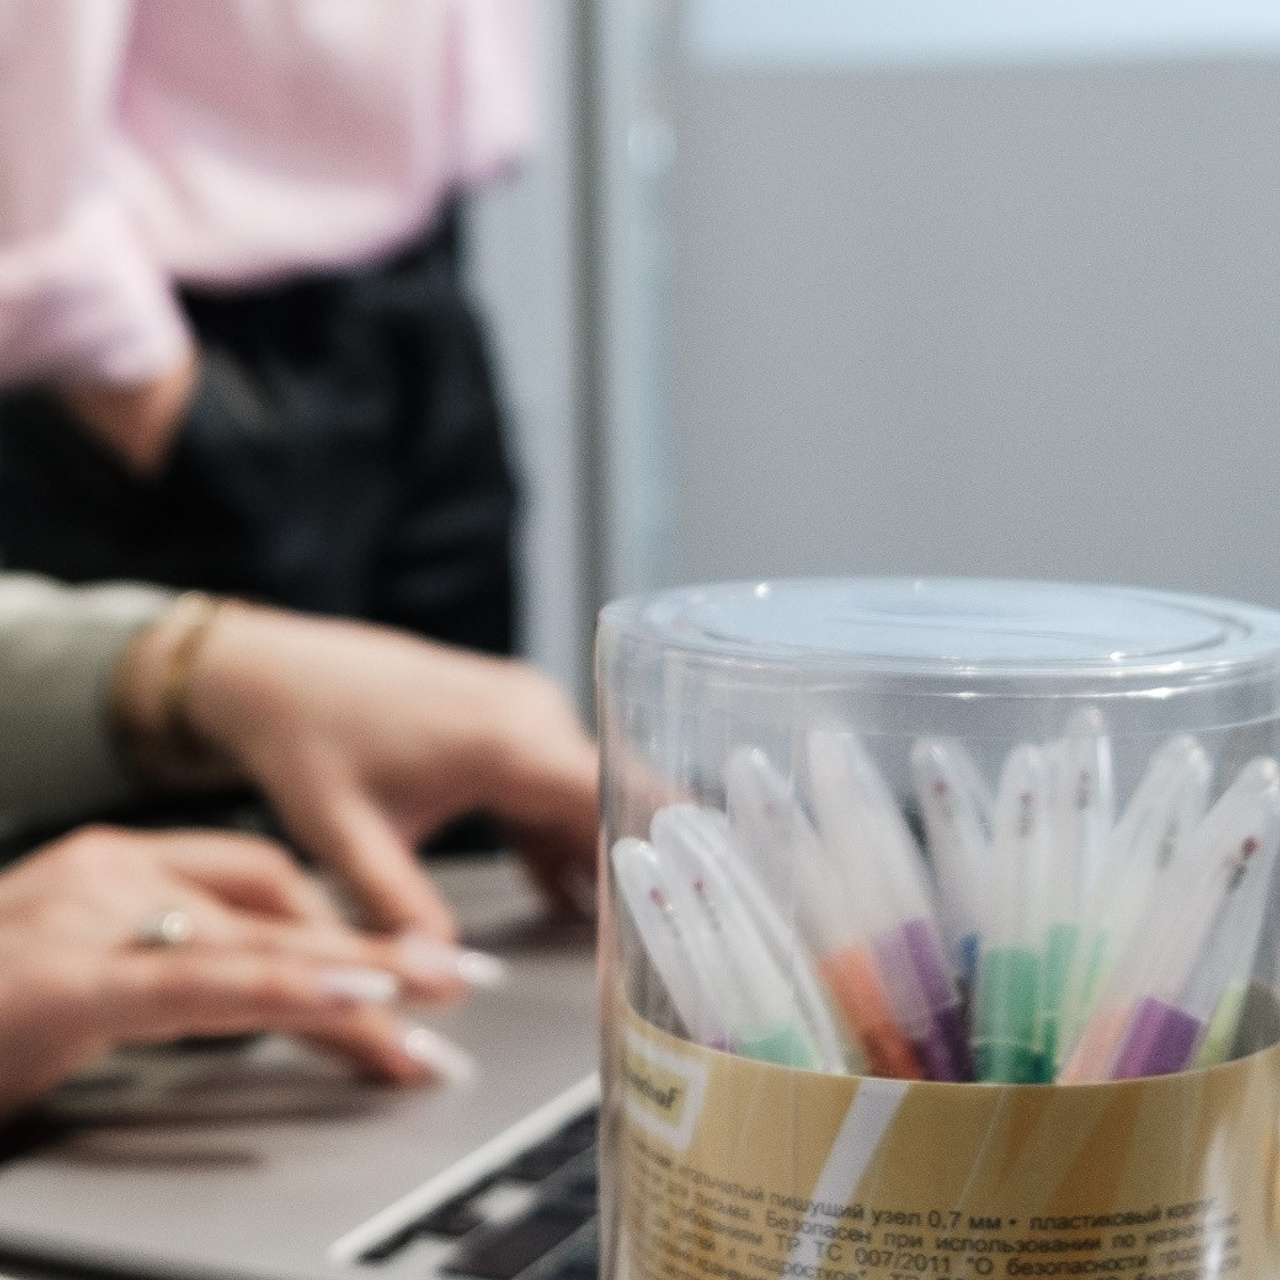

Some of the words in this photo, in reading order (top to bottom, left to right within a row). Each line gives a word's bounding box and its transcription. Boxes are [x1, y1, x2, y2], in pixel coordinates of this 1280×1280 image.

[871, 1207, 922, 1227] узел
[927, 1209, 962, 1231] 0,7
[883, 1233, 924, 1250] при
[814, 1241, 843, 1262] ТС
[854, 1248, 951, 1274] 007/2011
